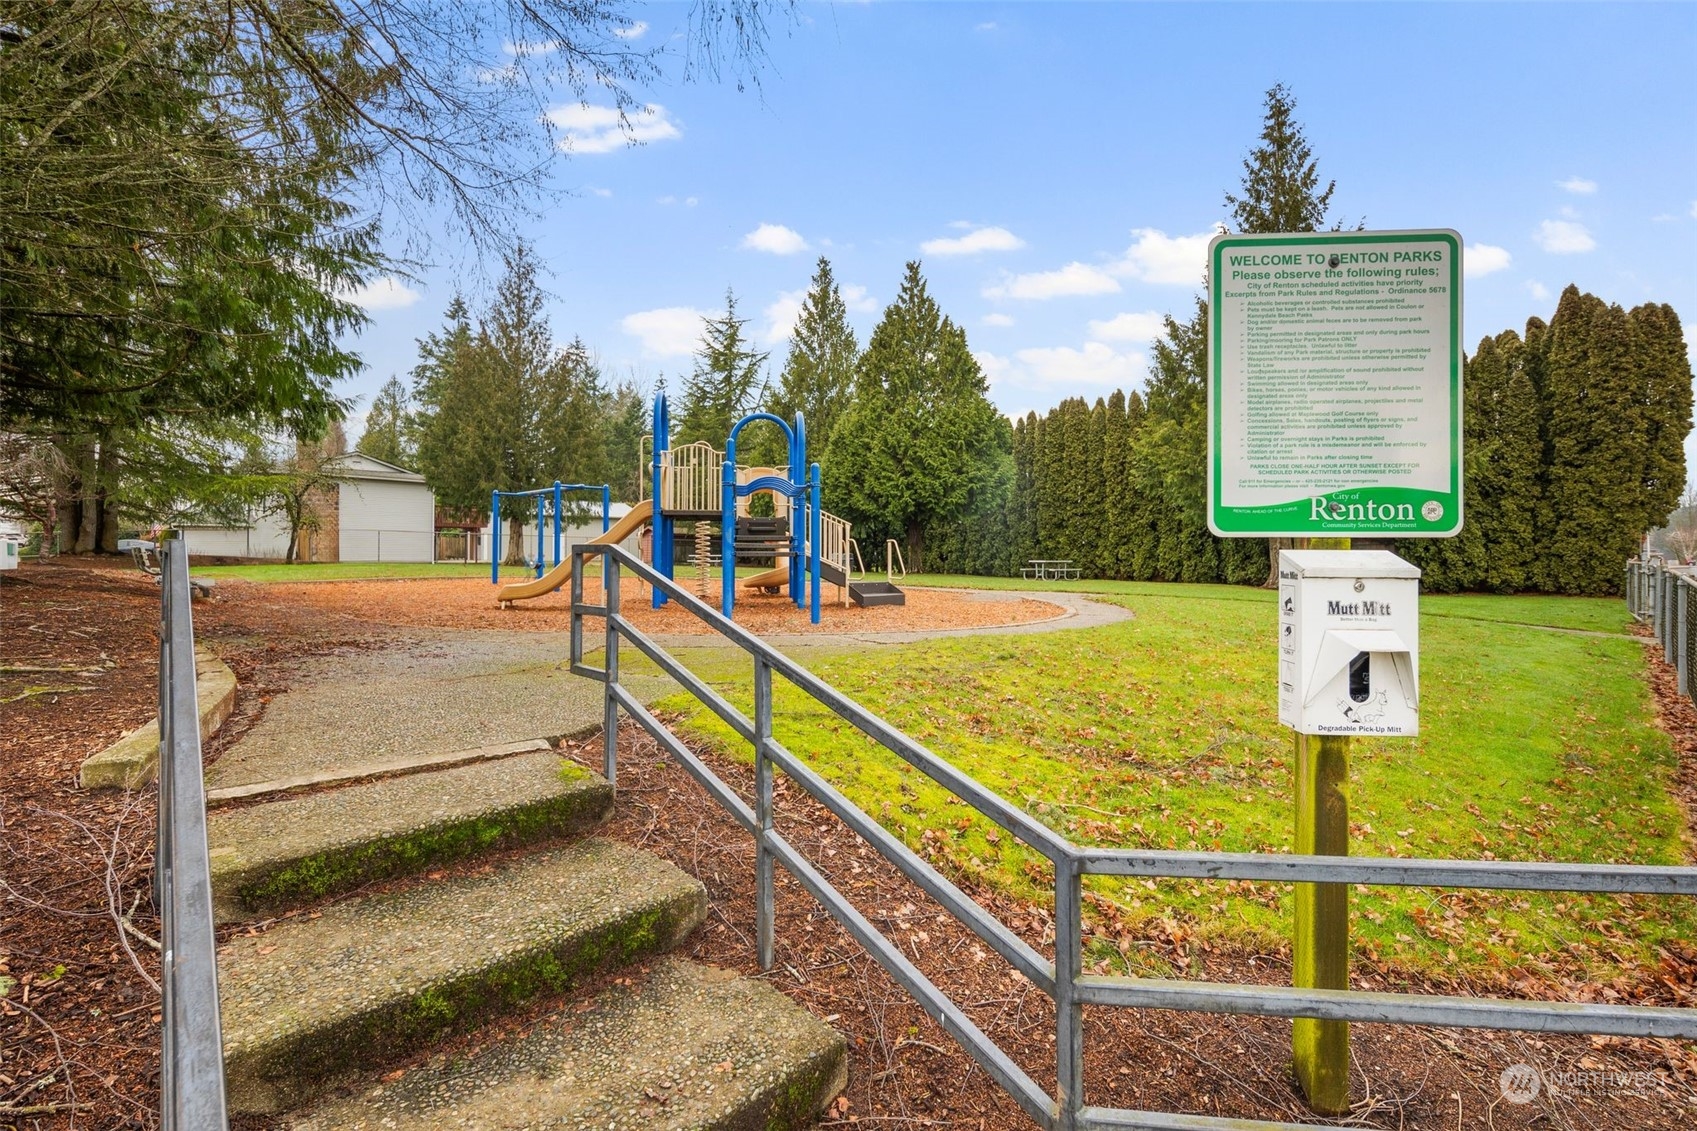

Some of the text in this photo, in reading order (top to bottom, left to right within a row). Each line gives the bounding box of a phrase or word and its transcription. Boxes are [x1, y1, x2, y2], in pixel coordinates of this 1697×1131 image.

[1230, 254, 1302, 266] WELCOME
[1307, 254, 1325, 264] TO
[1393, 251, 1441, 262] PARKS
[1232, 267, 1438, 280] Please observe the following rules;
[1225, 290, 1257, 299] Excerpts
[1334, 288, 1379, 296] Regulations
[1332, 492, 1359, 501] City of
[1308, 496, 1415, 521] Renton
[1327, 600, 1391, 615] Mutt Mtt
